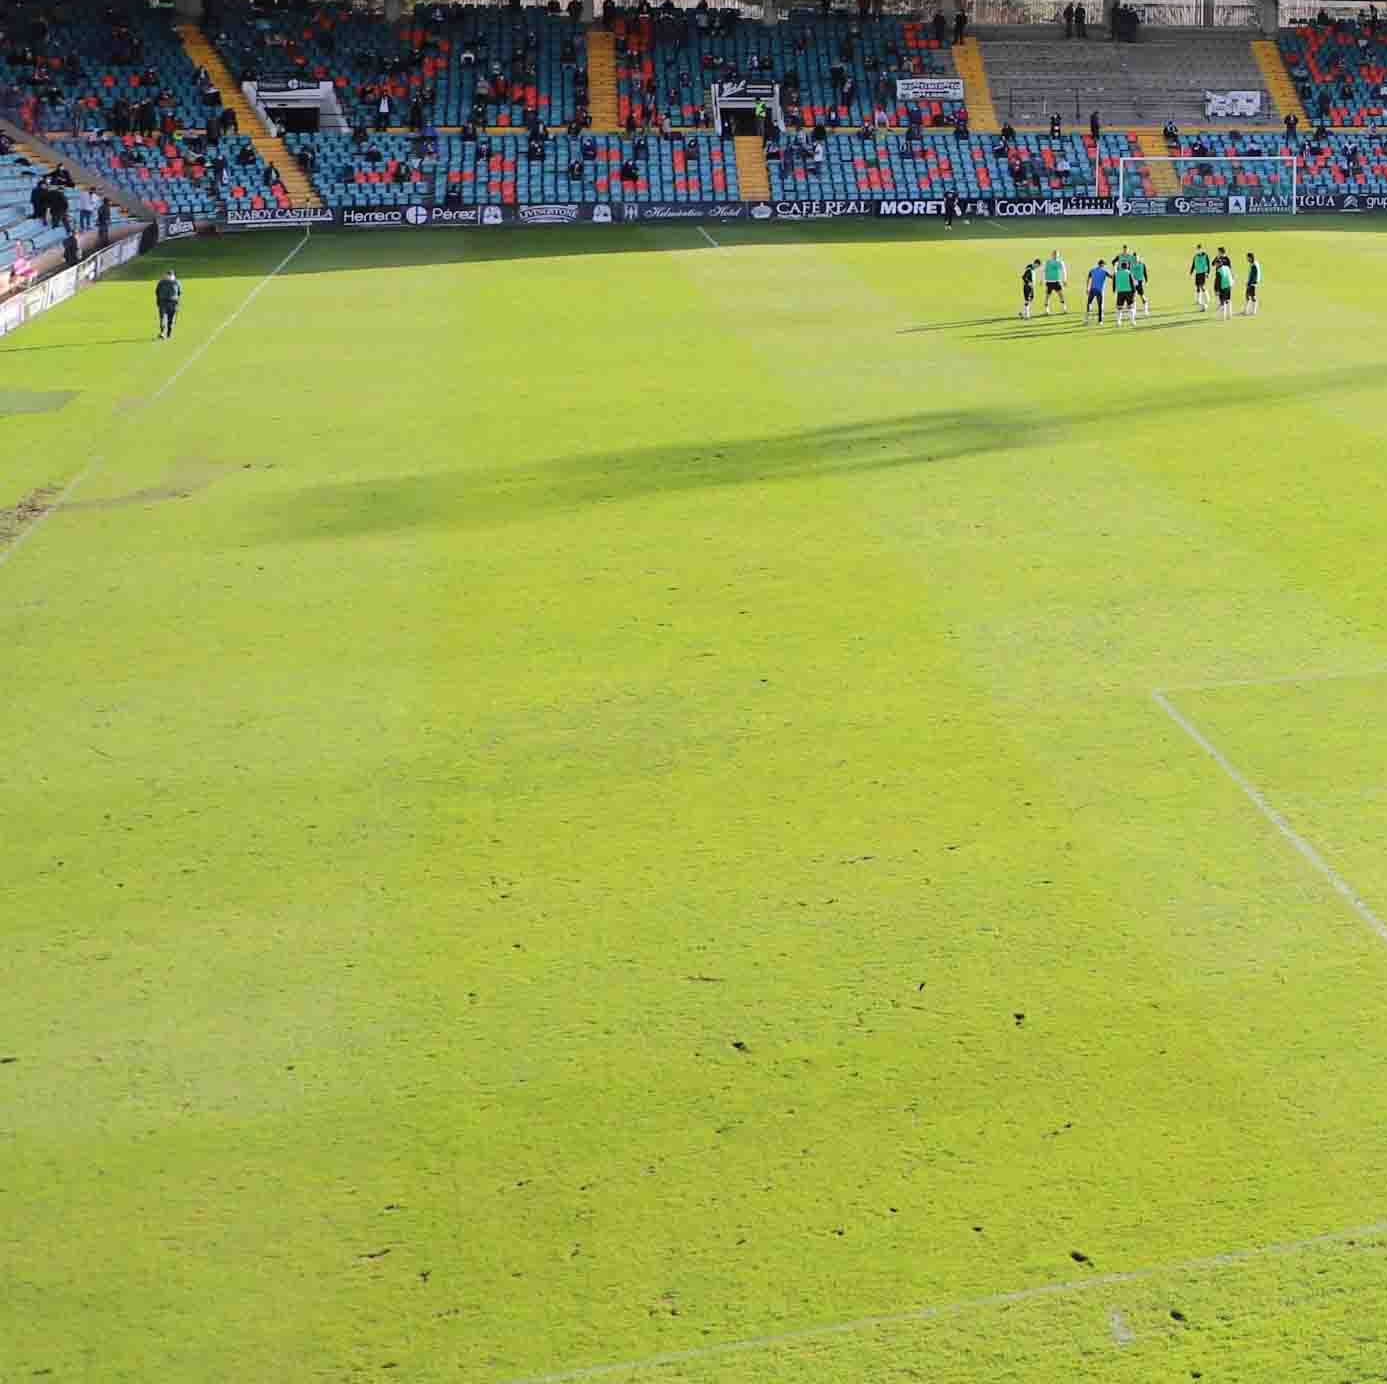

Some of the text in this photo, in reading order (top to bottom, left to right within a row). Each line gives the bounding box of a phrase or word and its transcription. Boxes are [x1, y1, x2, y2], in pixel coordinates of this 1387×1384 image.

[276, 208, 333, 219] CASTILLA
[776, 199, 869, 216] CAFÉ REAL
[997, 199, 1063, 216] CocoMiel
[343, 209, 401, 222] Herrero
